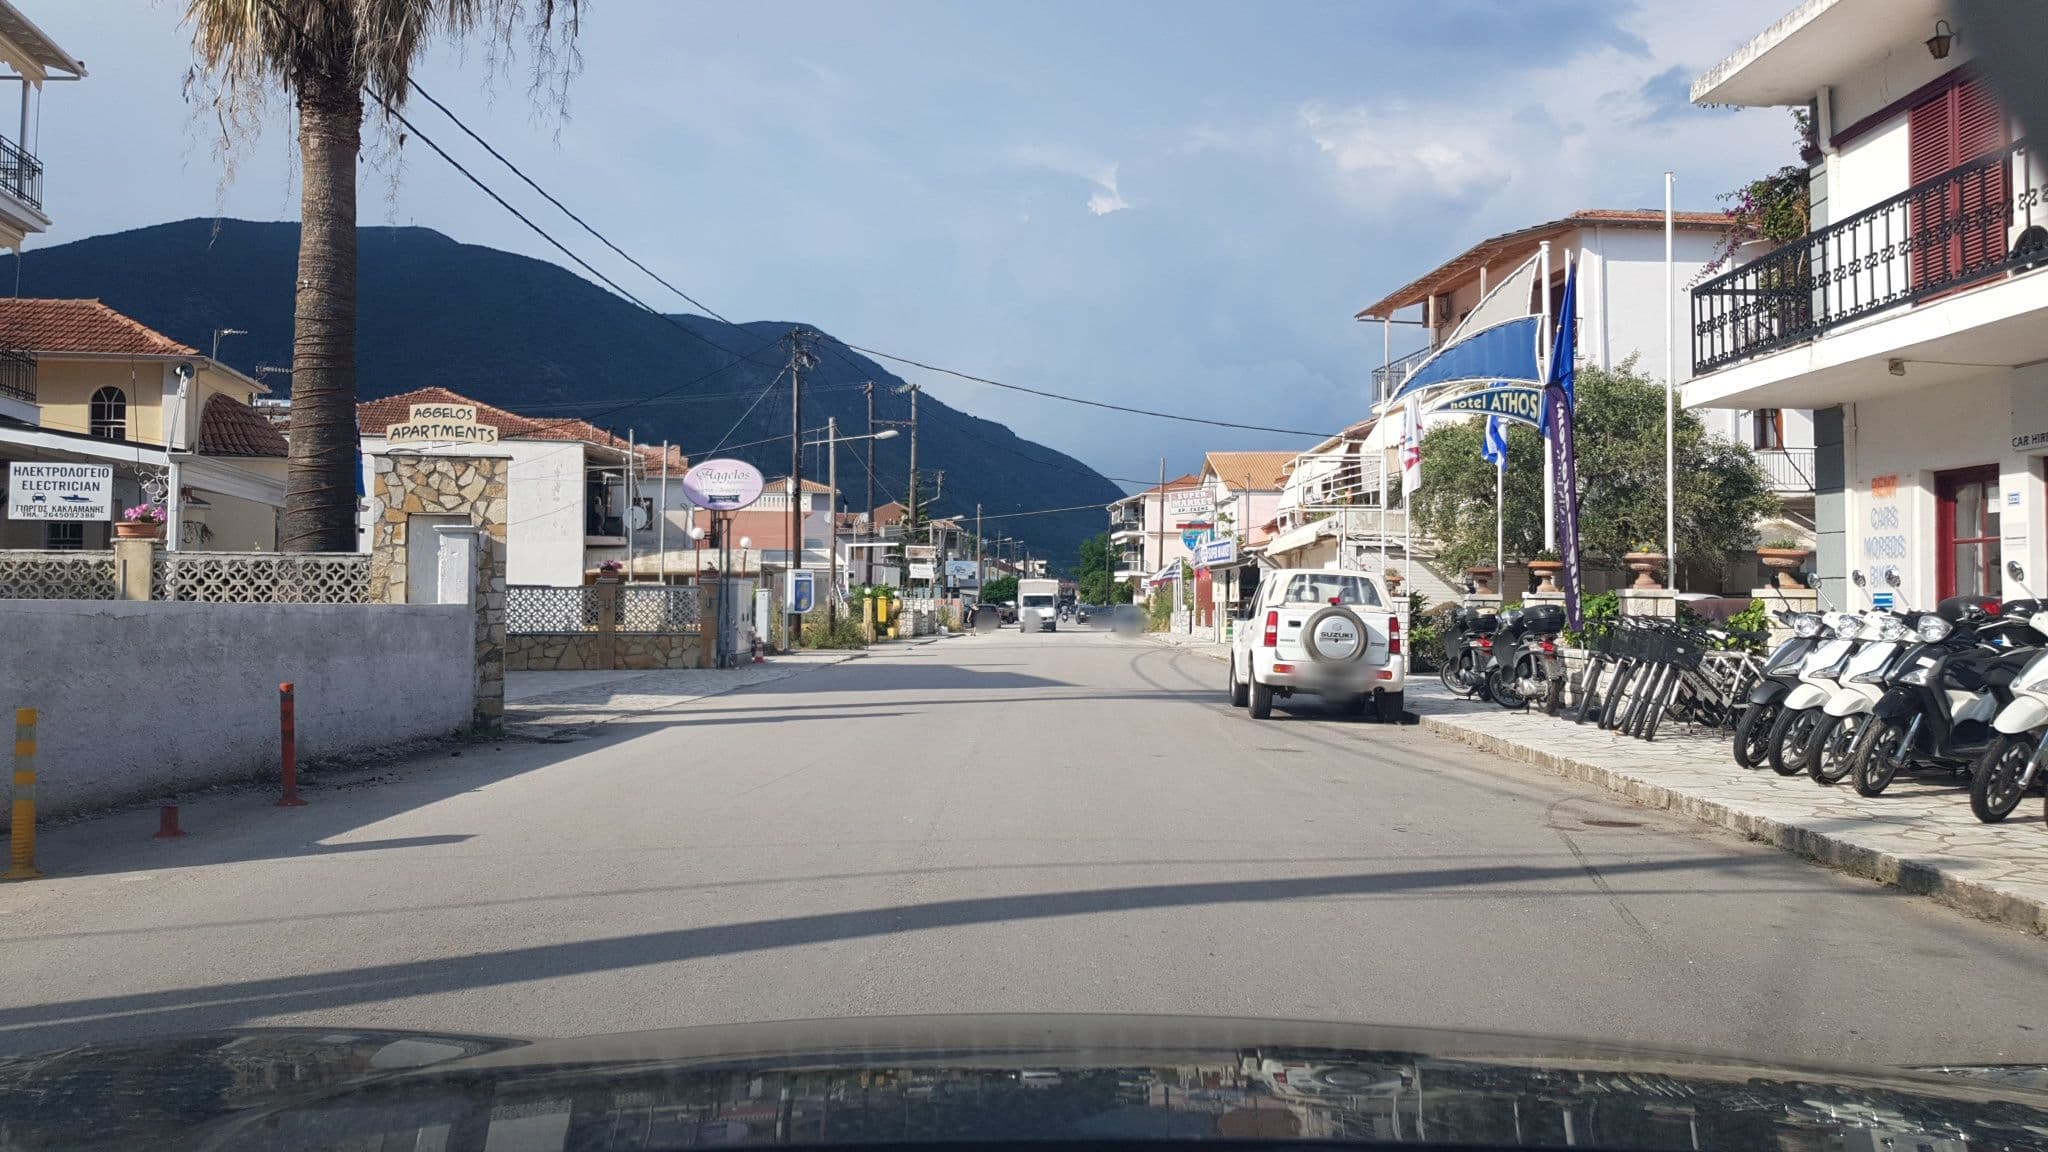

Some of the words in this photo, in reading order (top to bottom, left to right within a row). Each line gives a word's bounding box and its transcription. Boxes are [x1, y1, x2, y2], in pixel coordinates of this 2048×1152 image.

[1490, 391, 1538, 419] ATHOS
[414, 407, 474, 420] AGGELOS
[390, 424, 495, 443] APARTMENTS
[2011, 436, 2029, 448] CAR
[13, 466, 110, 478] ΗΛΕΚΤΡΟΛΟΓΕΙΟ
[696, 467, 751, 483] Aggelos
[22, 480, 100, 491] ELECTRICIAN
[1177, 491, 1206, 500] SUPER
[52, 505, 104, 513] ΚΑΚΛΑΜΑΝΗΣ
[1172, 498, 1212, 508] MARKET
[1320, 631, 1353, 639] SUZUKI
